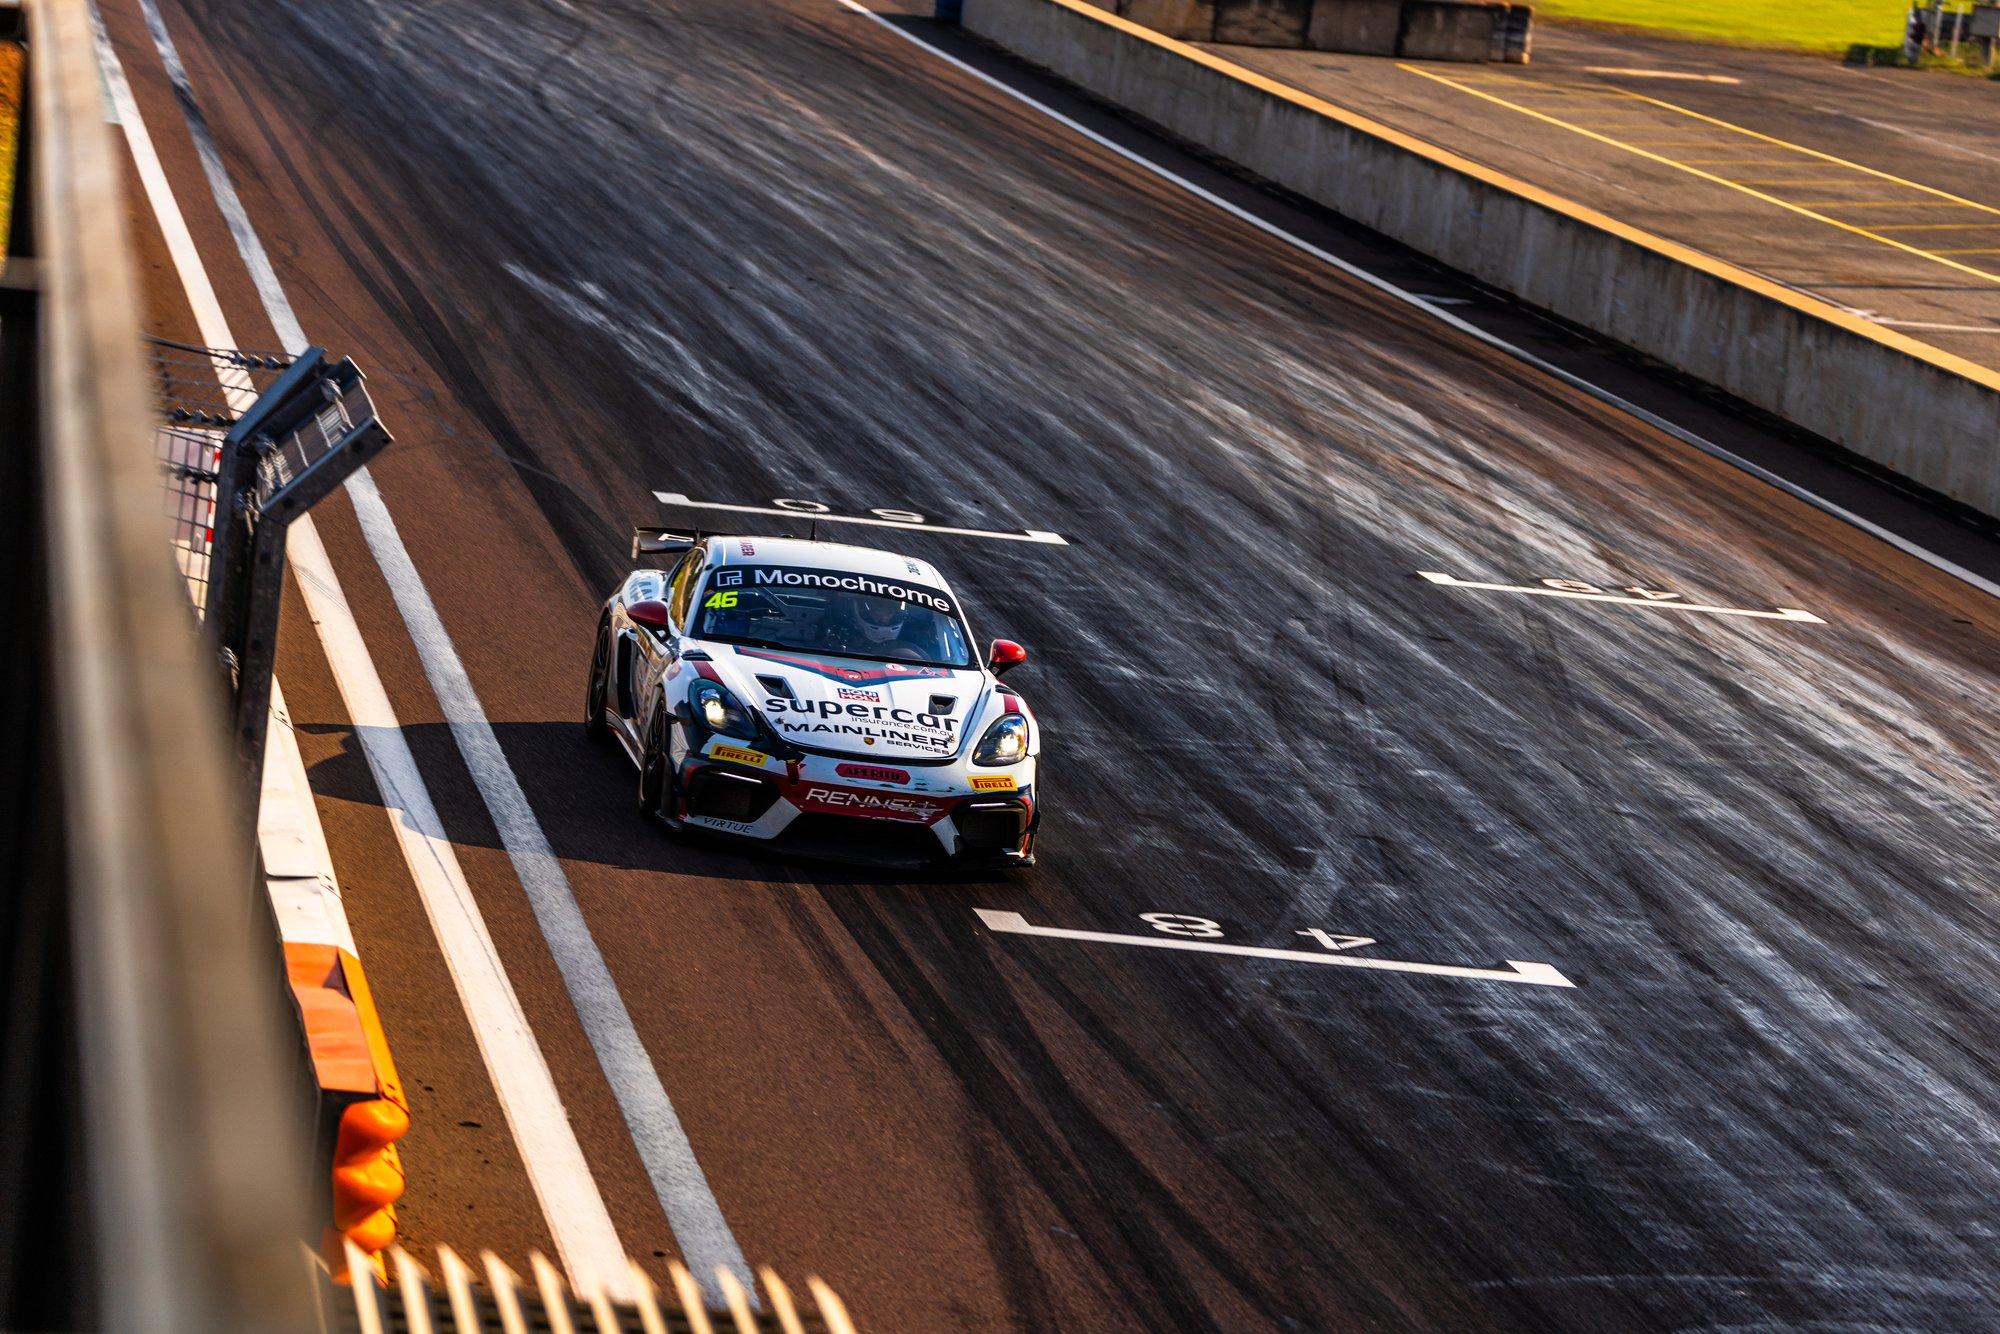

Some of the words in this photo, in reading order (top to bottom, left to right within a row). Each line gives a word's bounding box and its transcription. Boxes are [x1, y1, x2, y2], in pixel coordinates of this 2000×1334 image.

[705, 591, 738, 609] 46
[755, 569, 951, 612] Monochrome
[765, 697, 959, 732] supercar
[783, 723, 950, 749] MAINLINER
[851, 716, 955, 738] insurance.com.au
[714, 746, 764, 764] PIRELLI
[886, 739, 950, 756] SERVICES
[972, 777, 1014, 789] PIRELLI
[704, 817, 753, 834] VIRTUE
[1138, 912, 1377, 951] 48
